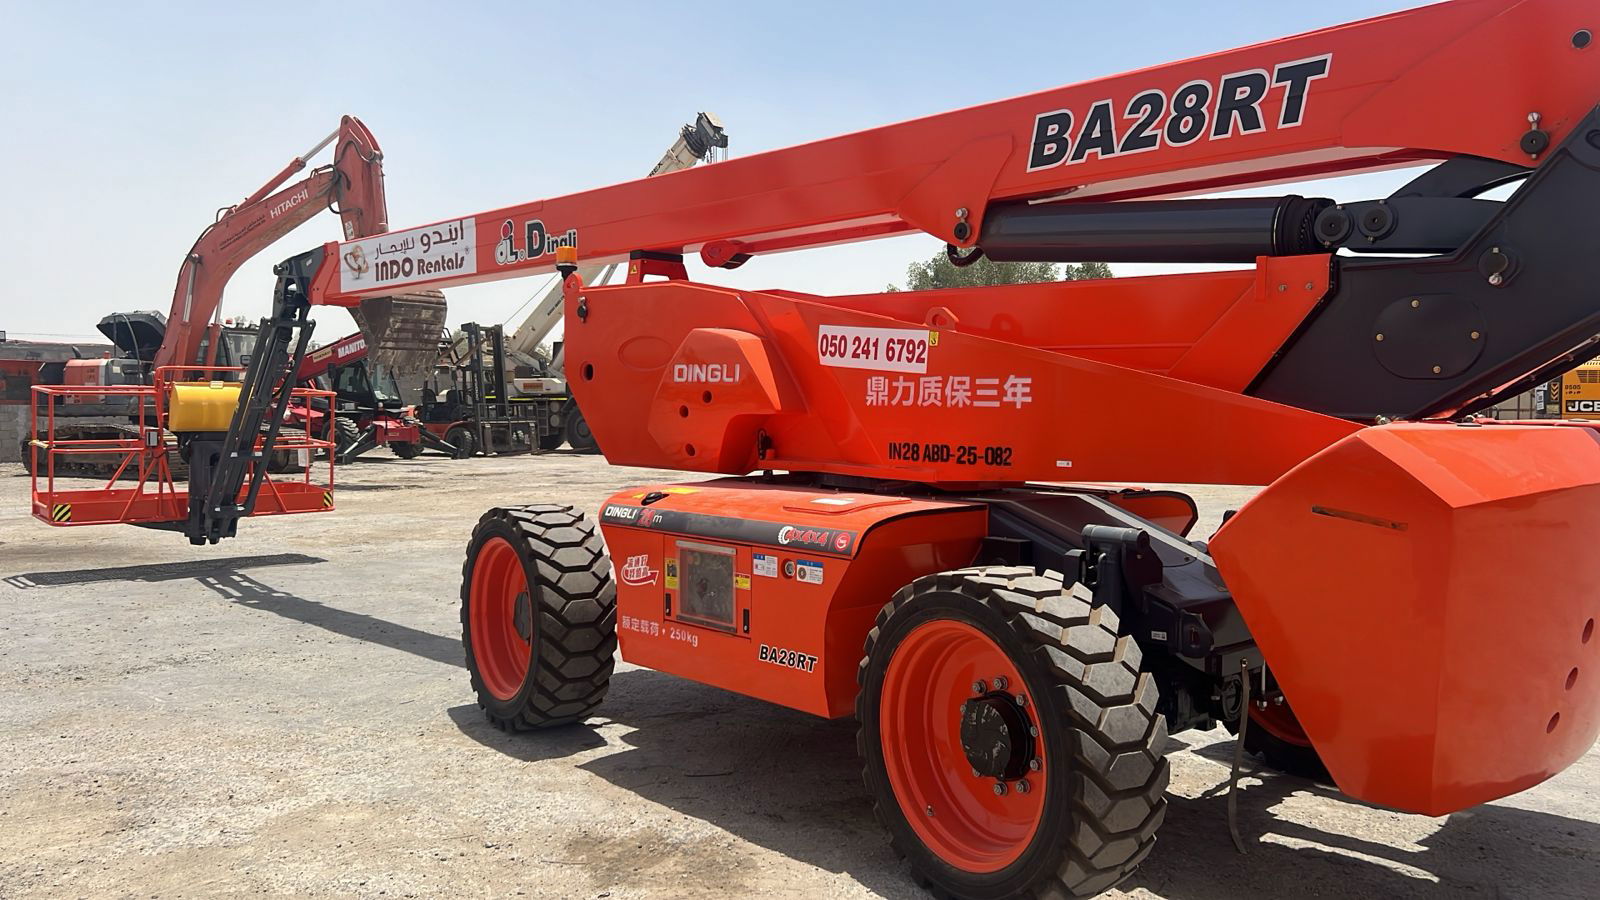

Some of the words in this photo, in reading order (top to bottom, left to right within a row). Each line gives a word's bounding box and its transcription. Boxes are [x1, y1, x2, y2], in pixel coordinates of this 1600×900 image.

[1026, 53, 1333, 173] BA28RT
[270, 189, 309, 219] HITACHI
[420, 219, 464, 253] ايندو
[375, 257, 414, 281] INDO
[417, 252, 464, 275] Rentals
[337, 339, 367, 359] MANITO
[819, 333, 847, 358] 050
[851, 335, 879, 361] 241
[885, 338, 927, 364] 6792
[673, 363, 740, 383] DINGLI
[866, 375, 1033, 409] 鼎力质保三年
[888, 442, 920, 462] IN28
[922, 443, 1013, 467] ABD-25-082
[604, 506, 637, 519] DINGLI
[670, 627, 698, 647] 250kg
[758, 644, 818, 674] BA28RT
